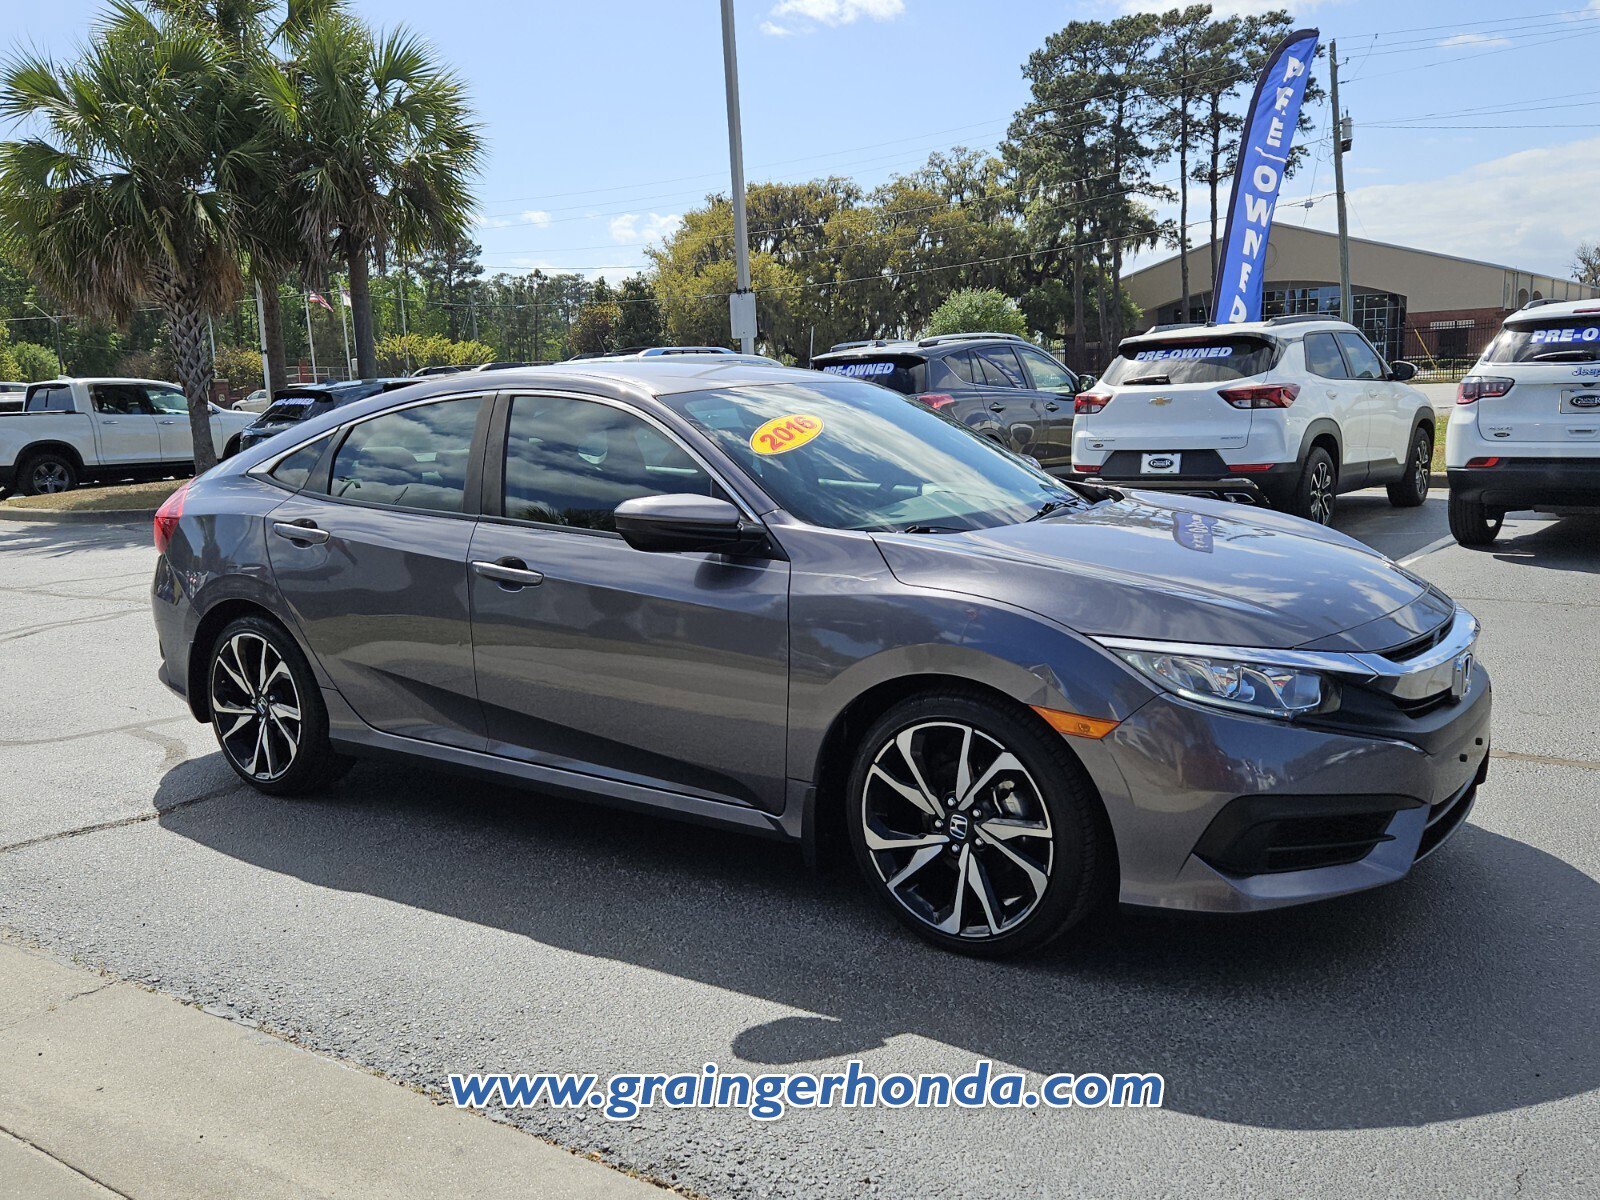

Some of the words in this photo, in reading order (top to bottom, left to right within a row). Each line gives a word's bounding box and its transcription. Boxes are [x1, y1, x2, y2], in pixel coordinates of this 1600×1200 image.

[1530, 327, 1600, 344] PRE-O
[1134, 346, 1233, 361] PRE-OWNED
[759, 416, 817, 451] 2016
